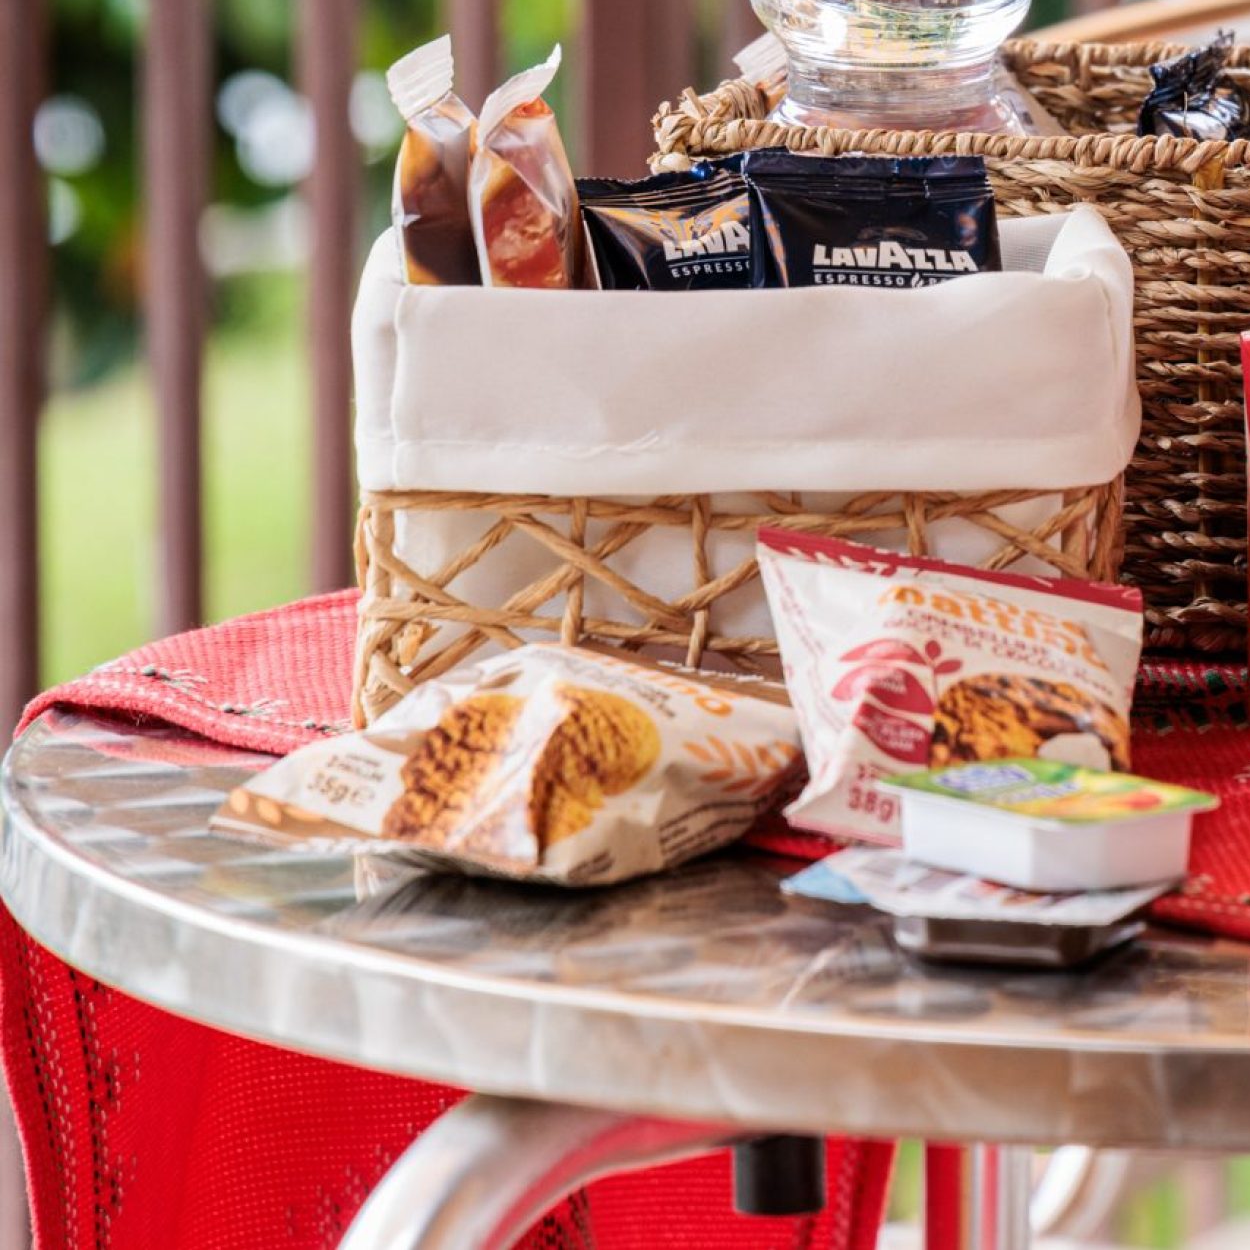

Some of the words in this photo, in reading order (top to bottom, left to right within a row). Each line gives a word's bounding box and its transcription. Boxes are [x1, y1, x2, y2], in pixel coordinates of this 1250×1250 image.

[663, 220, 751, 261] LAVA
[812, 240, 978, 272] LAVAZZA
[813, 273, 905, 287] ESPRESSO
[306, 771, 349, 806] 35g
[848, 786, 895, 823] 38g
